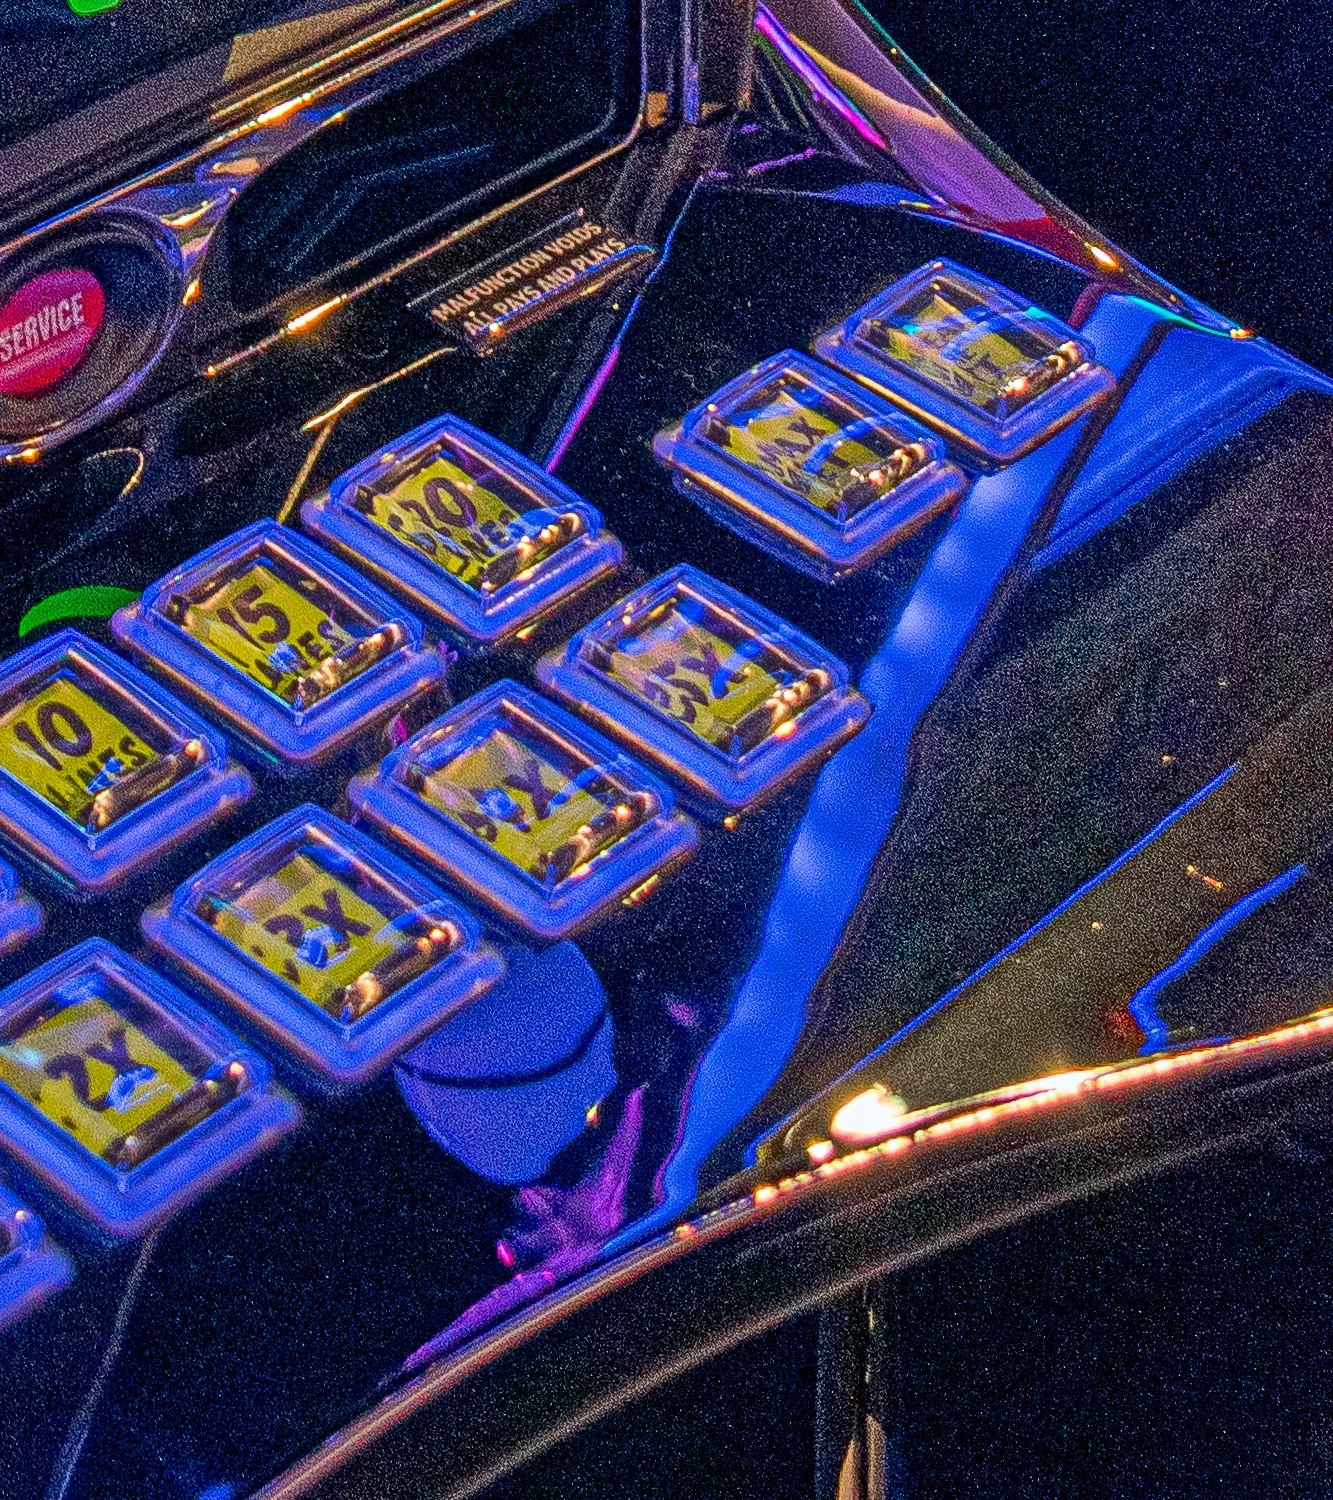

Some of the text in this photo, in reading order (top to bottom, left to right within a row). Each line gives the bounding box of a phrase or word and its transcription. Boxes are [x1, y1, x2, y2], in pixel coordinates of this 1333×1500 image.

[431, 222, 602, 322] MALFUNCTION VOIDS
[493, 285, 542, 316] PAYS
[537, 264, 576, 292] AND
[571, 237, 626, 271] PLAYS
[216, 584, 291, 651] 15
[14, 702, 93, 771] 10
